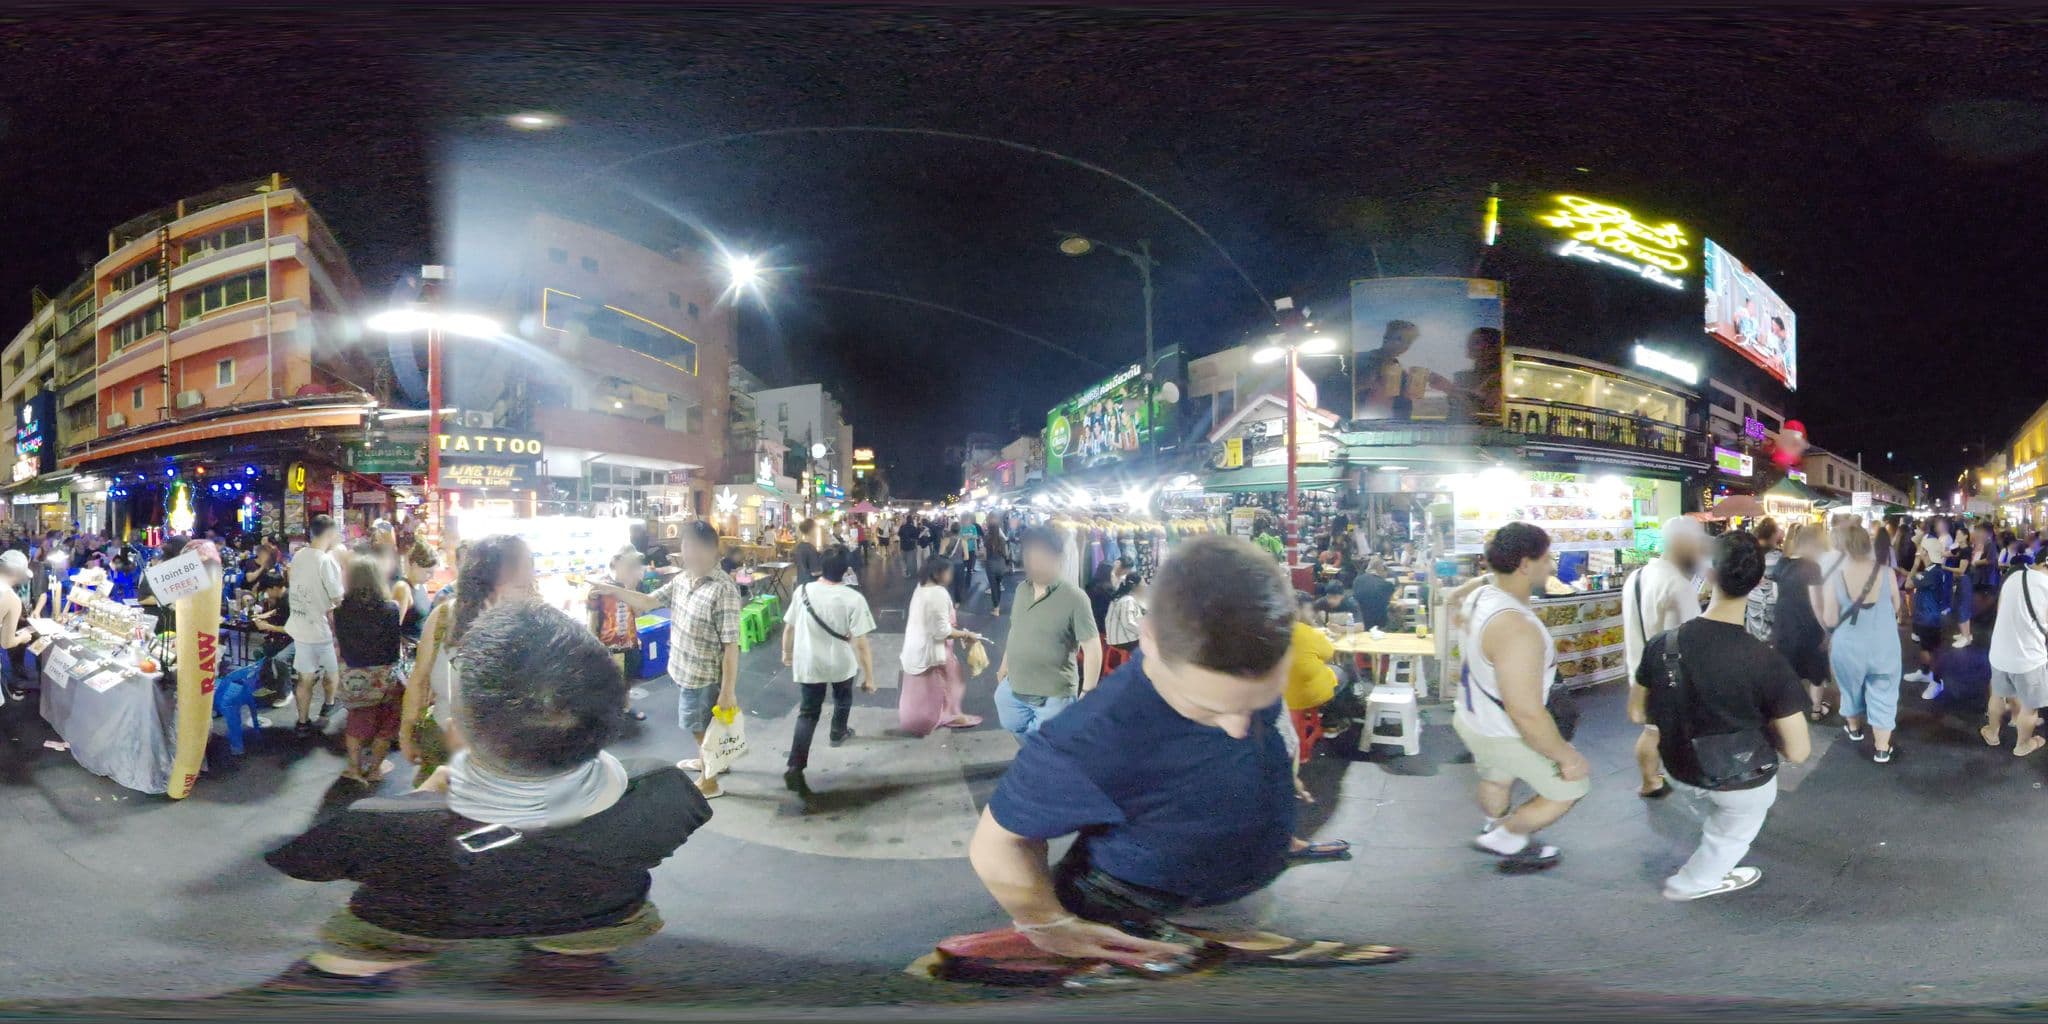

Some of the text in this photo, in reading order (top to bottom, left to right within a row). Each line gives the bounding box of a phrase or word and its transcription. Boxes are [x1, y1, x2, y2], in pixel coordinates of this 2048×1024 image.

[437, 435, 541, 454] TATTOO
[160, 568, 183, 582] Joint
[169, 579, 192, 593] FREE
[197, 631, 217, 696] RAW
